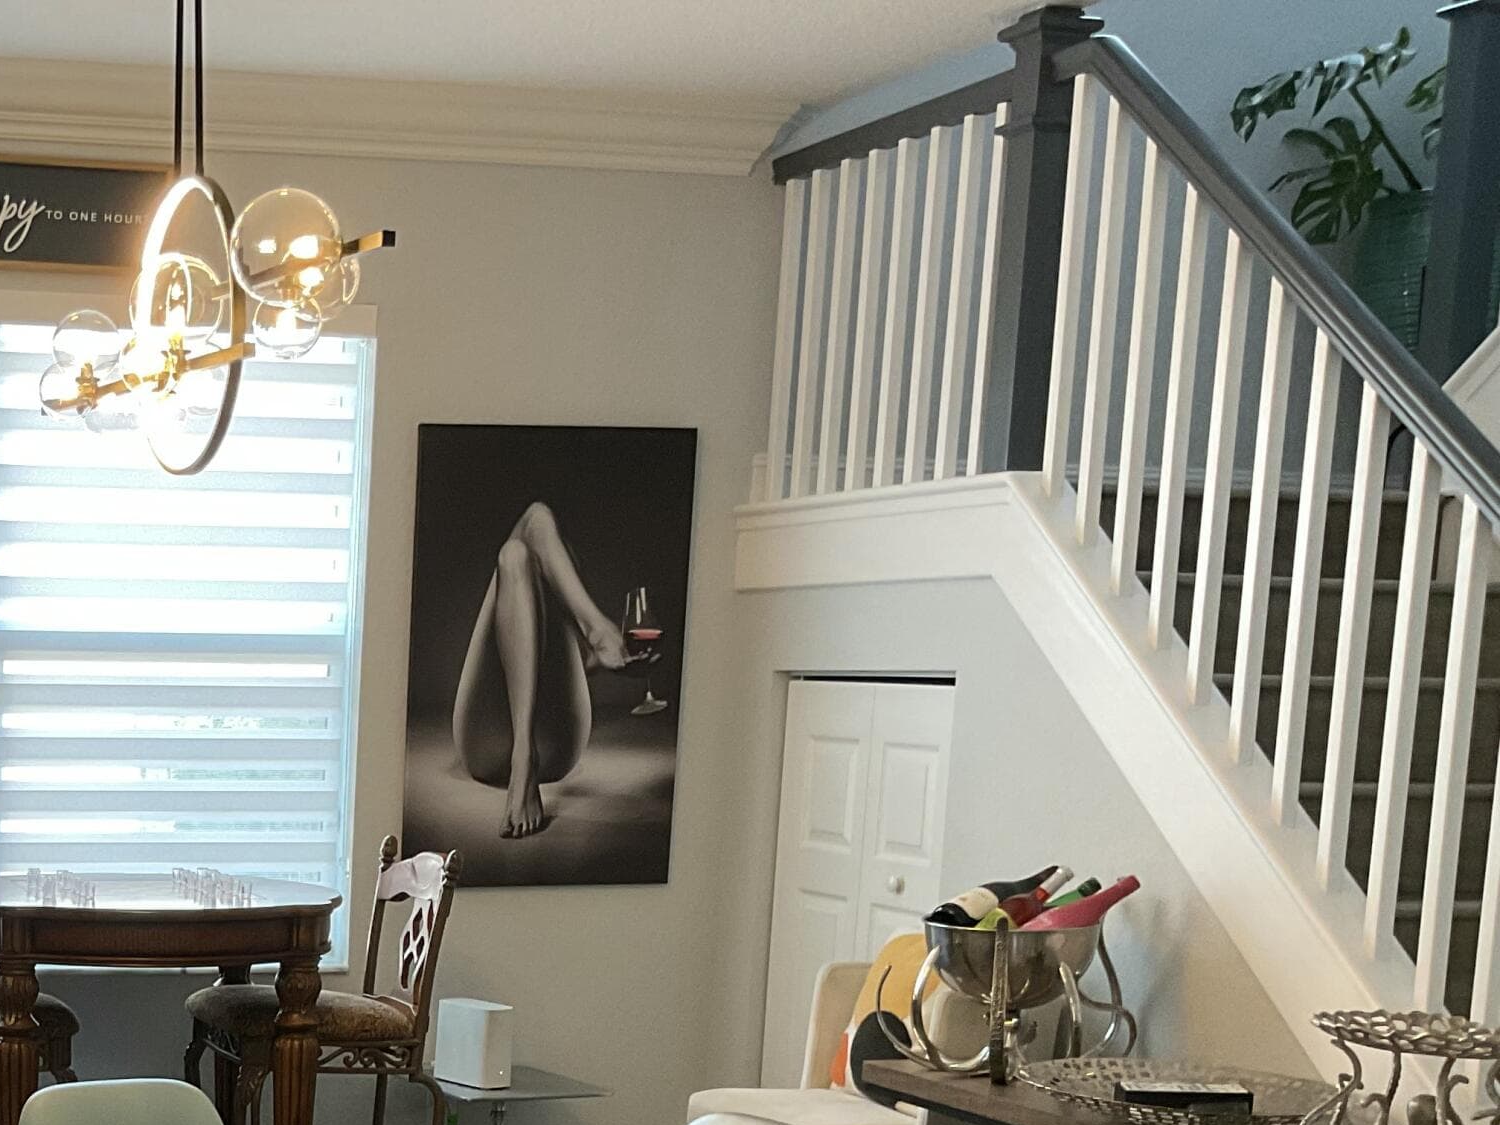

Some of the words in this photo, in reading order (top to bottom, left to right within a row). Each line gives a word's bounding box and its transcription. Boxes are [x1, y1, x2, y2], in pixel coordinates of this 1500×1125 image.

[45, 209, 63, 221] TO
[69, 211, 98, 223] ONE
[103, 212, 143, 225] HOUR
